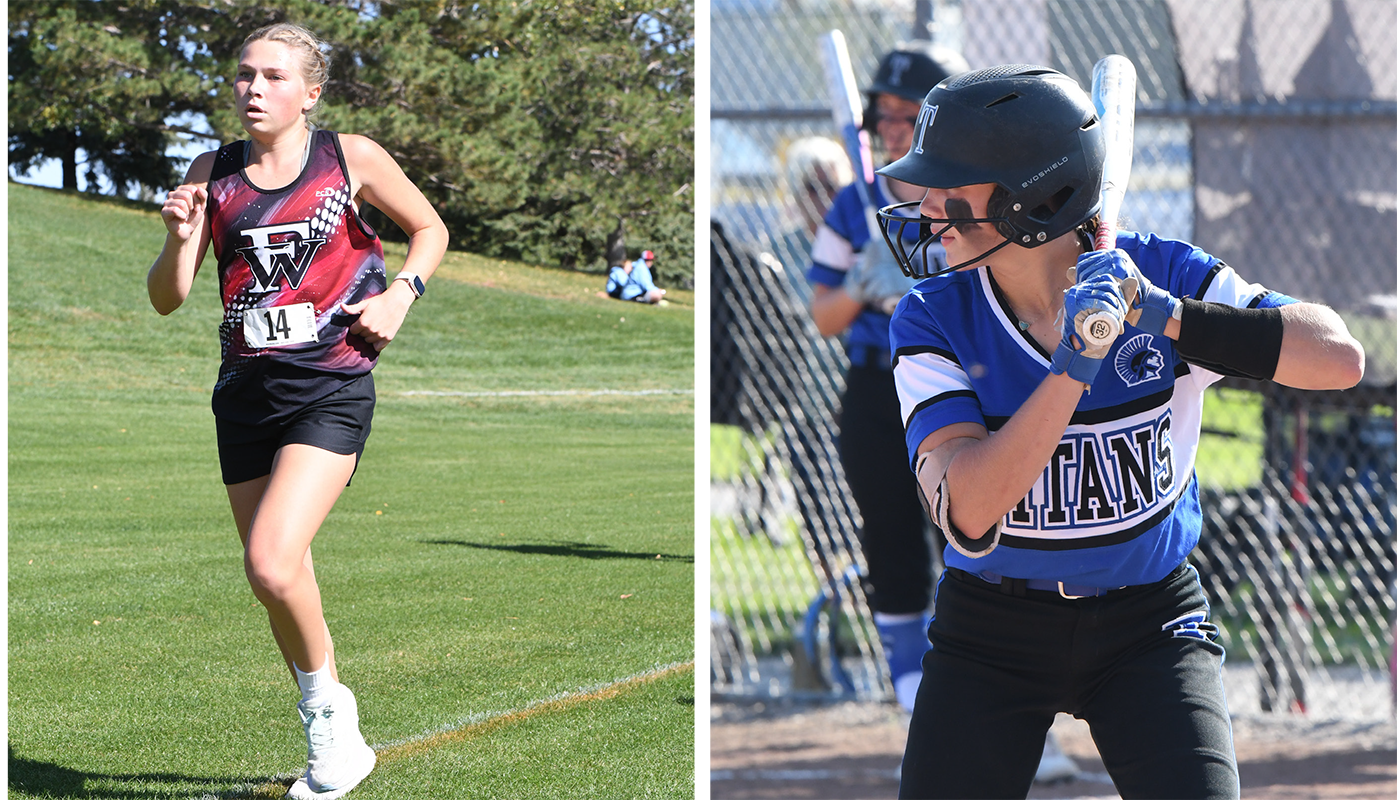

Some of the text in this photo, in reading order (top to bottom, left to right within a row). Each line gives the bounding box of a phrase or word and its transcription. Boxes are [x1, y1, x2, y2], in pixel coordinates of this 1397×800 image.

[888, 54, 911, 87] T
[914, 101, 939, 155] T
[264, 308, 291, 341] 14
